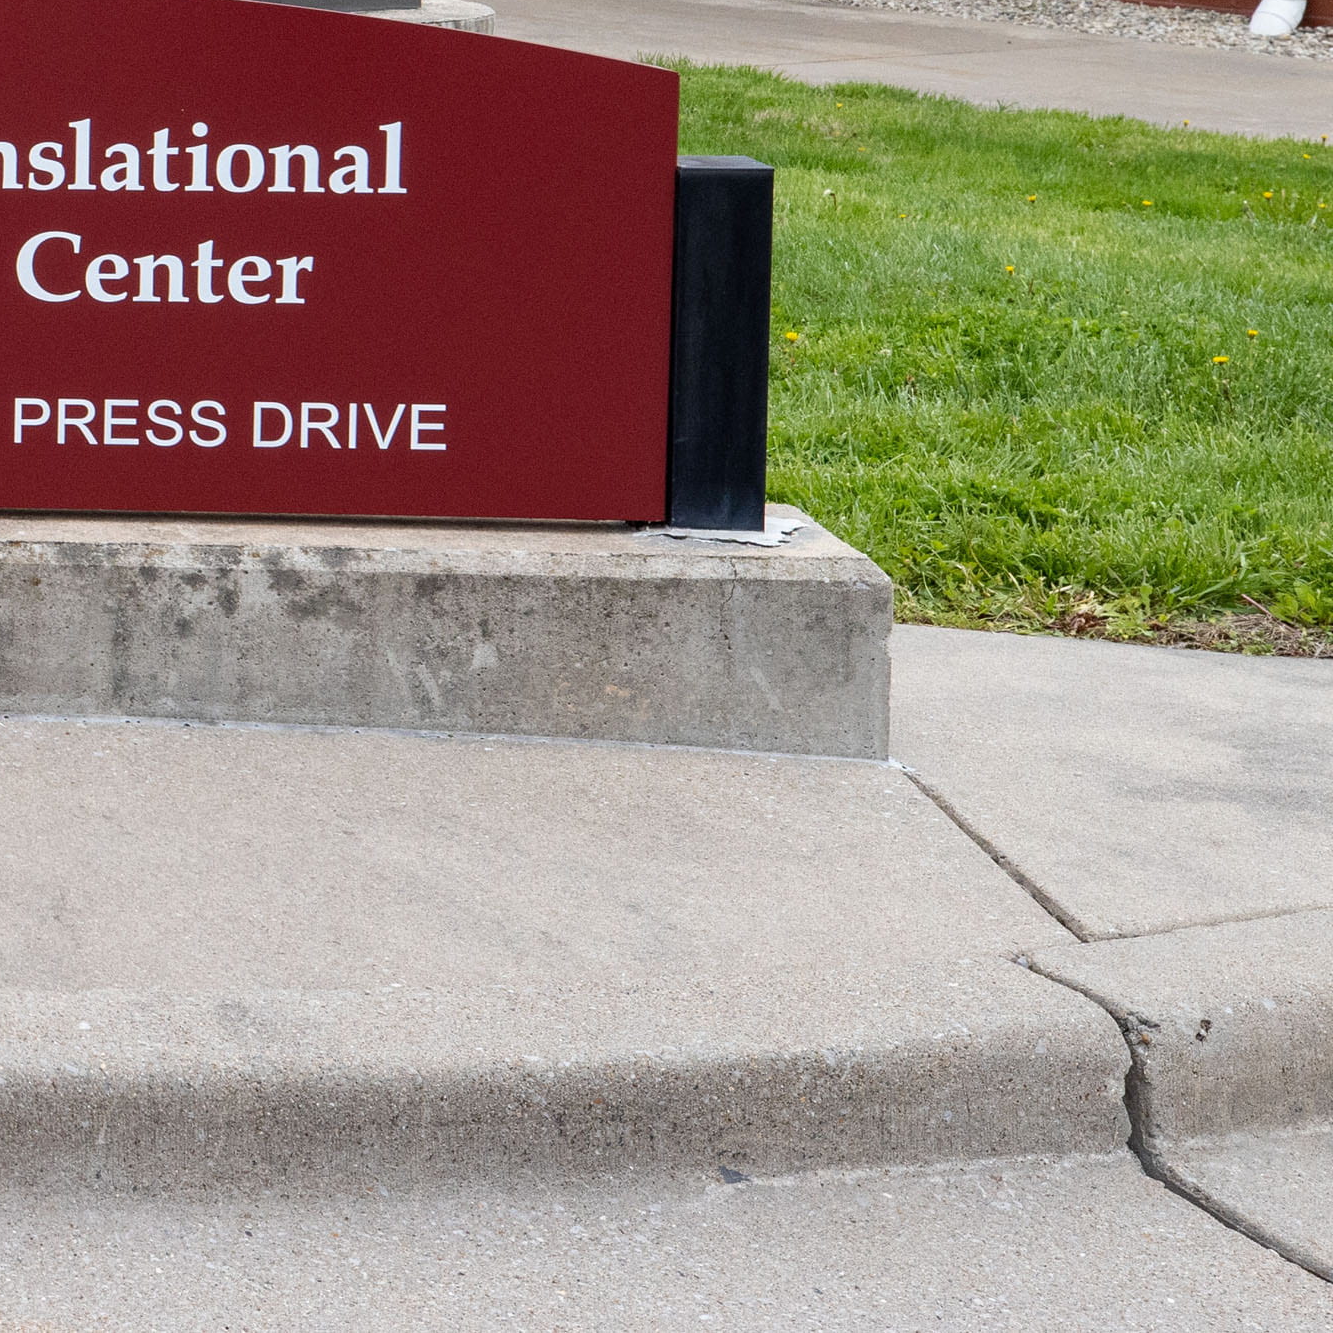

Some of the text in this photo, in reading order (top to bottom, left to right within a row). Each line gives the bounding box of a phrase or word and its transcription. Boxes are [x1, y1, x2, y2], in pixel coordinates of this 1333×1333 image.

[15, 230, 314, 305] Center
[13, 397, 227, 448] PRESS
[252, 401, 447, 451] DRIVE
